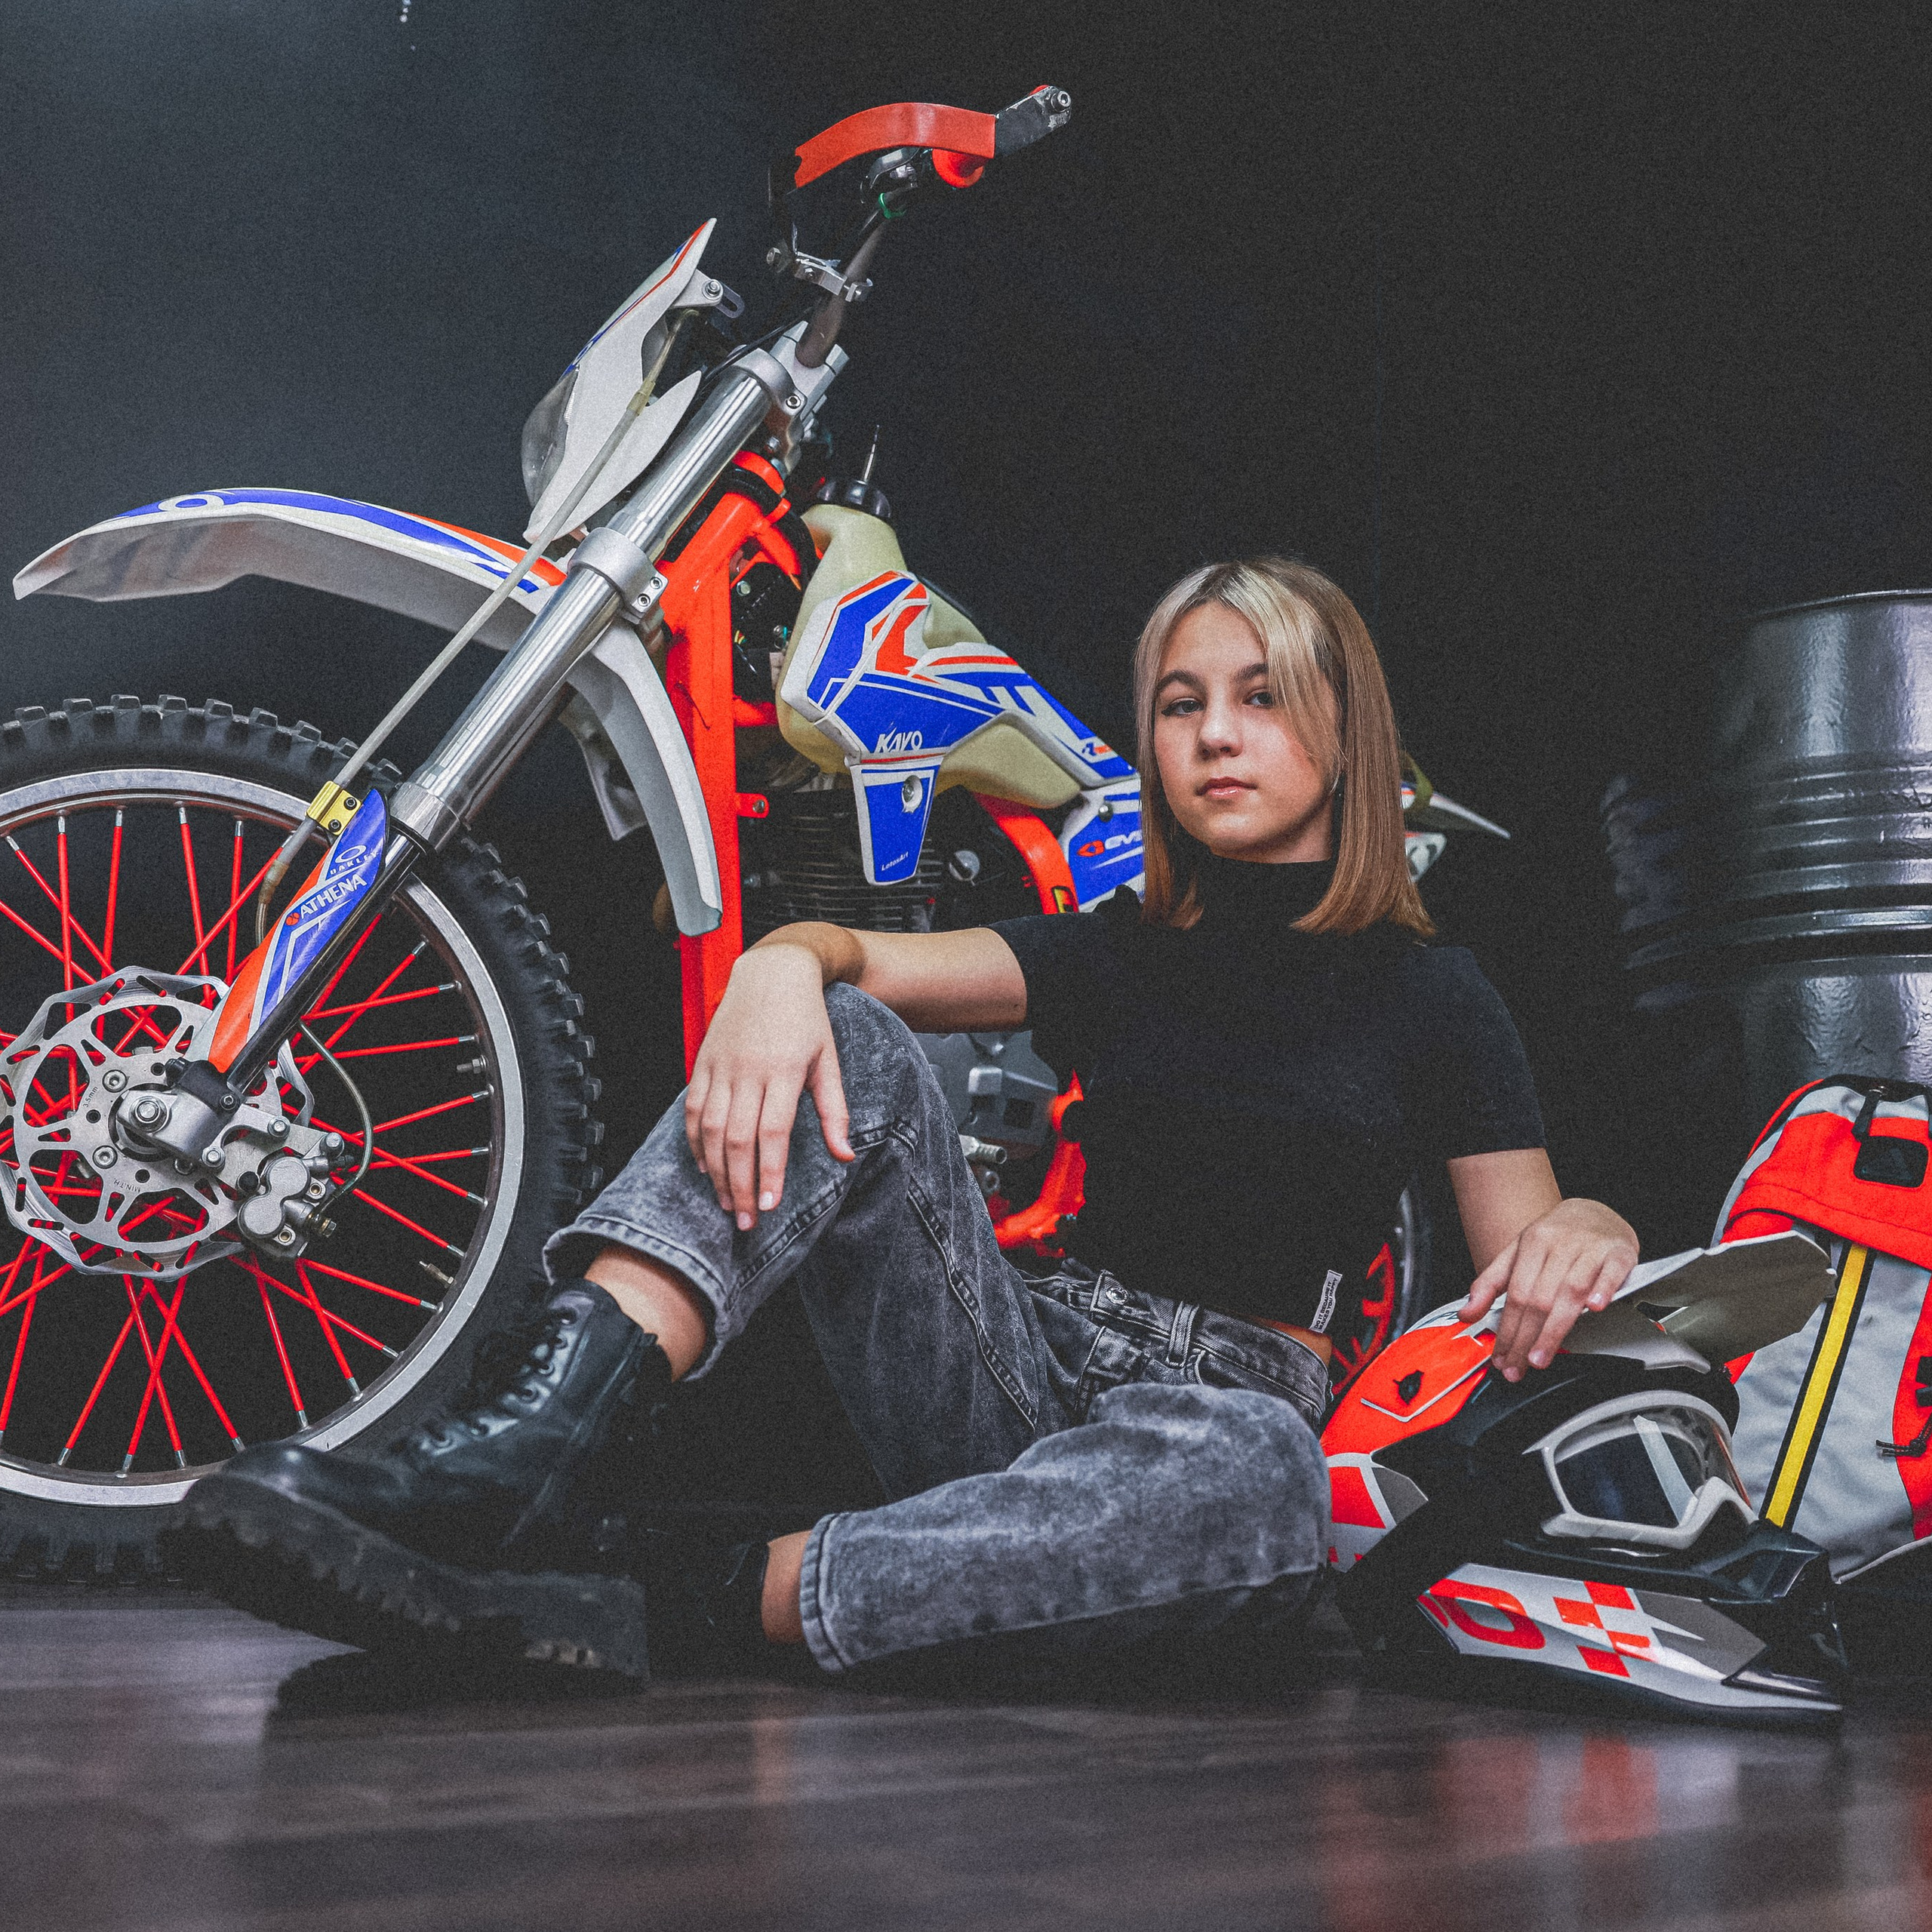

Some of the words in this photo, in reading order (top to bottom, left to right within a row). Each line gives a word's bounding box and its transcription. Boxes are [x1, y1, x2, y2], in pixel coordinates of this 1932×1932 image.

[874, 727, 923, 752] KAYO
[330, 851, 379, 875] OAKLEY
[300, 873, 368, 919] ATHENA
[83, 1086, 98, 1108] 3.5mm
[1314, 1320, 1320, 1328] DO
[1320, 1287, 1330, 1313] BECAUSE
[1318, 1309, 1330, 1329] MAKES
[1329, 1278, 1337, 1297] HAPPY
